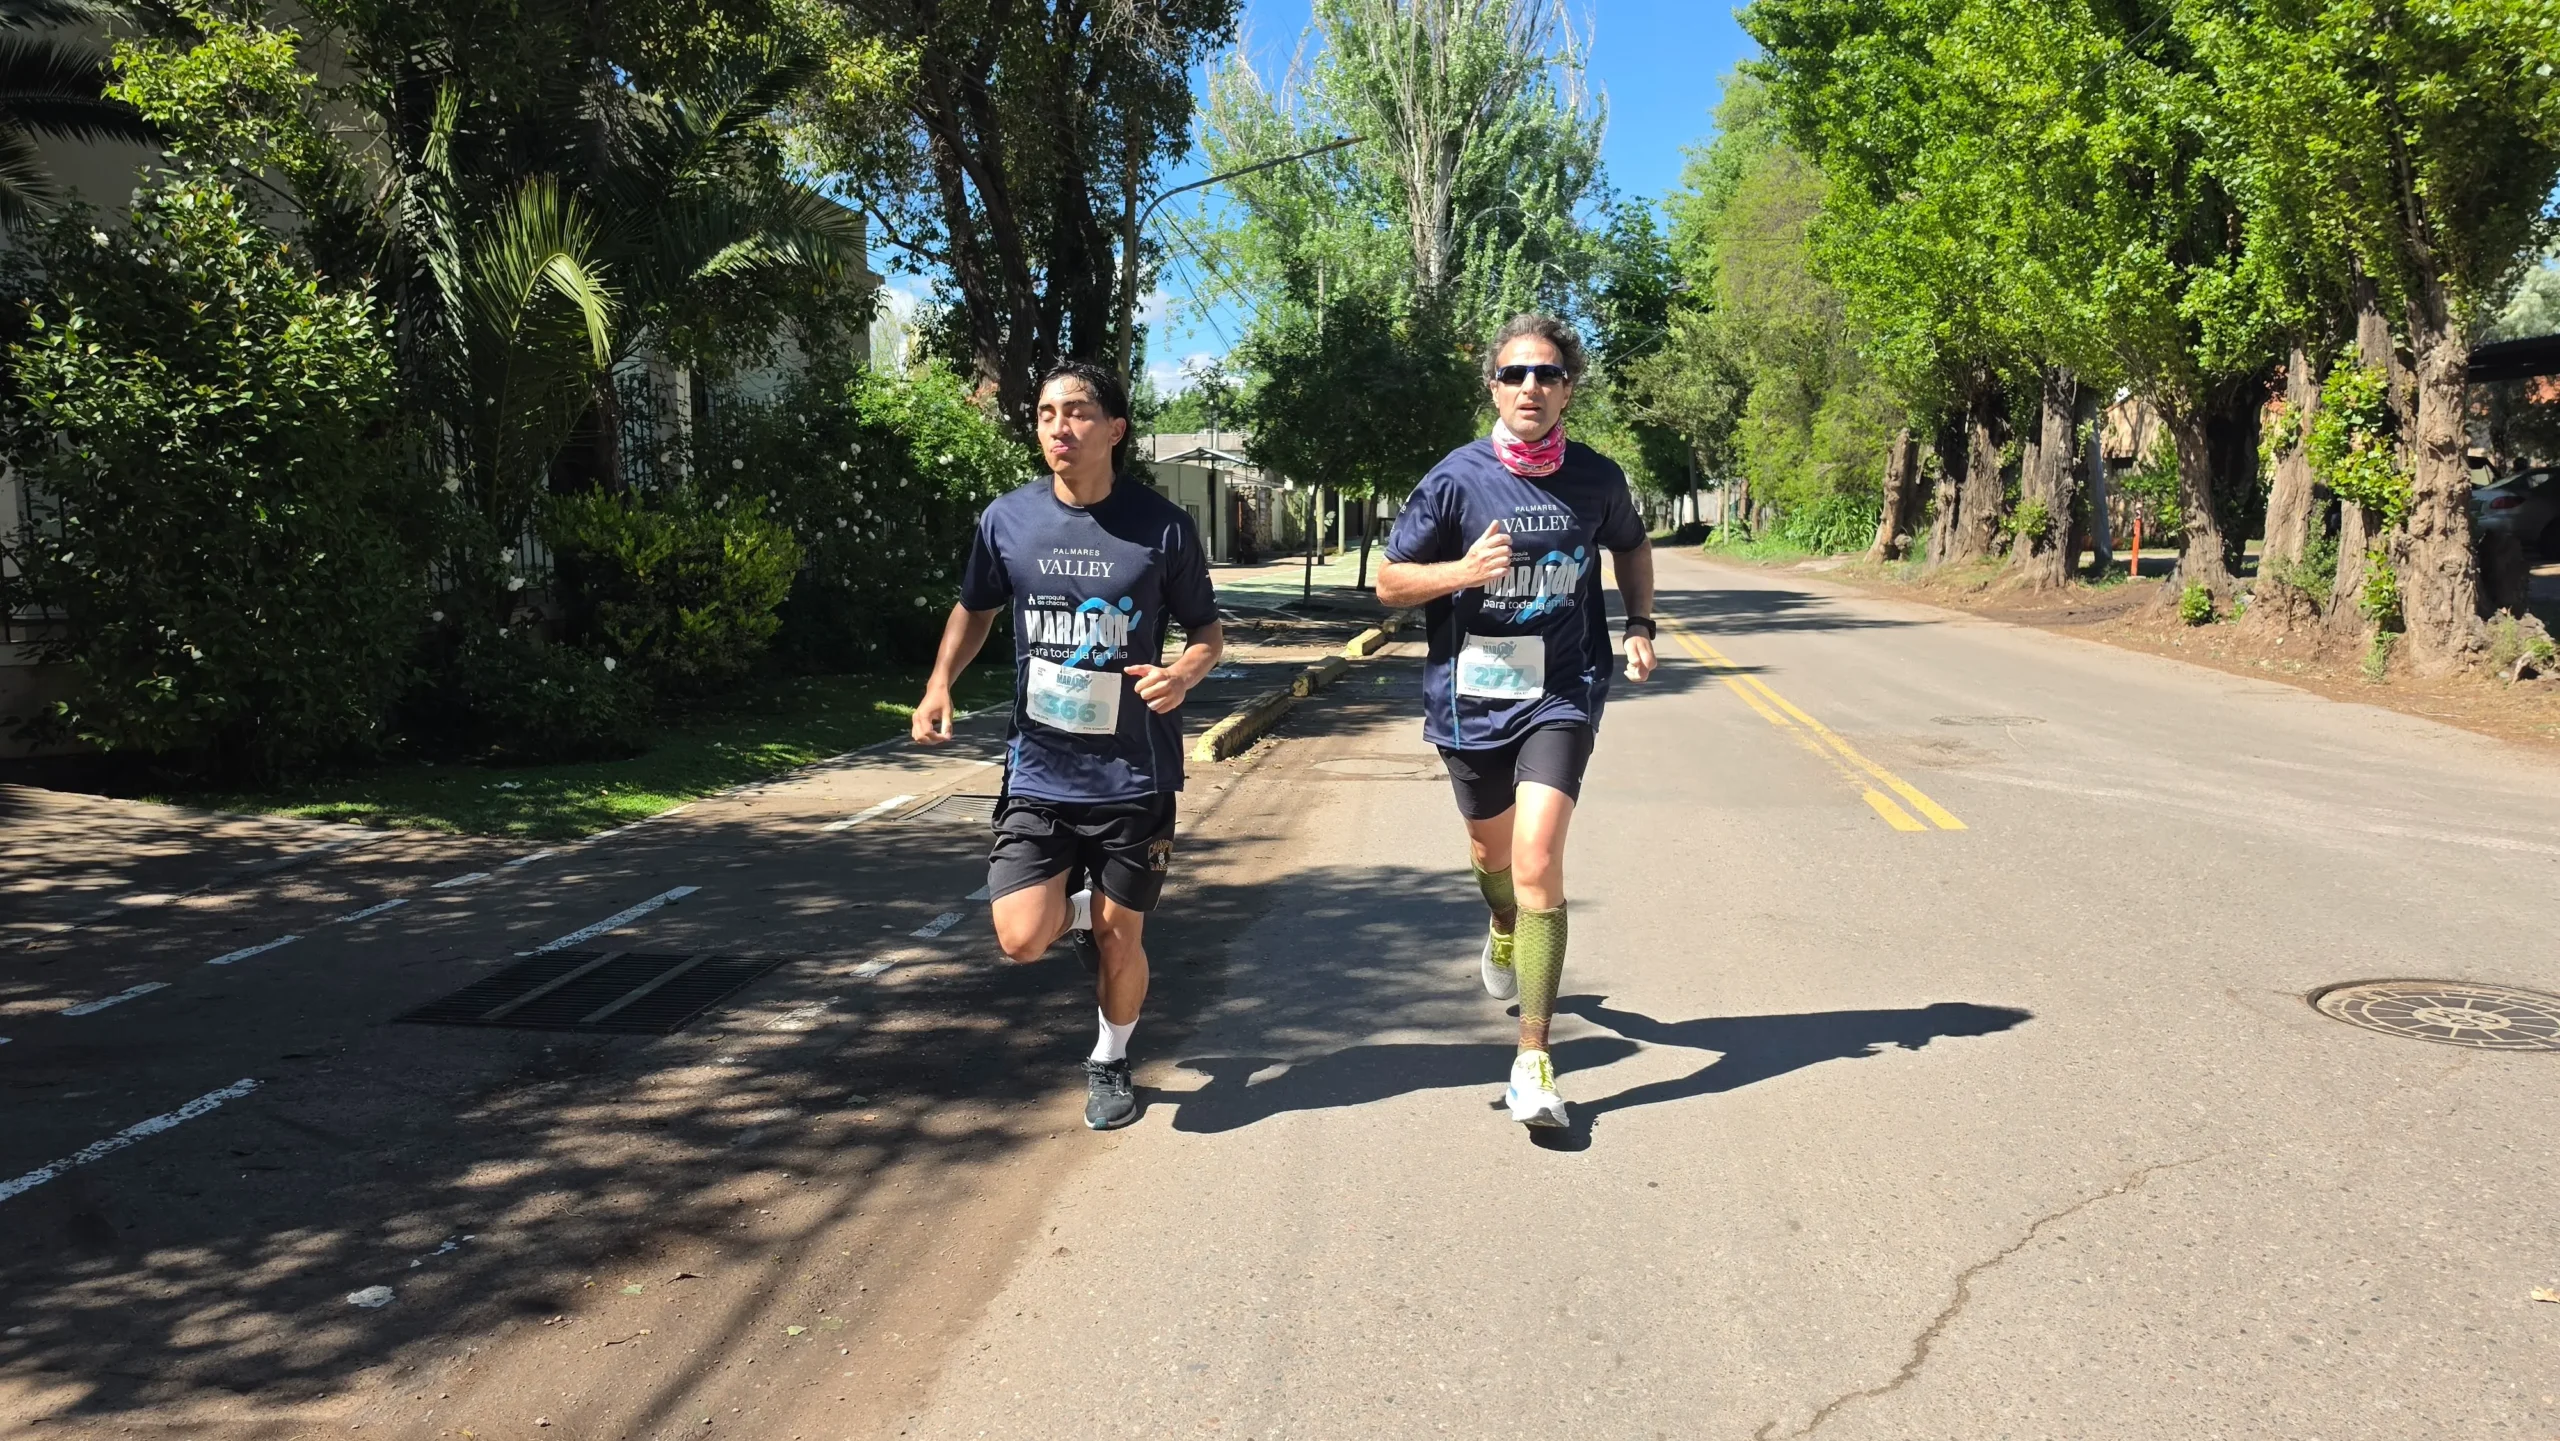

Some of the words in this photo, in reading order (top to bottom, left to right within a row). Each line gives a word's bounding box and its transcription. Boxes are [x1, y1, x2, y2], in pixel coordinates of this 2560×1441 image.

[1515, 504, 1557, 513] PALMARES
[1502, 515, 1570, 533] VALLEY
[1052, 548, 1100, 556] PALMARES
[1037, 559, 1115, 578] VALLEY
[1482, 599, 1506, 610] para
[1508, 600, 1533, 609] toda
[1535, 600, 1545, 610] la
[1050, 647, 1076, 659] toda
[1474, 666, 1524, 688] 277
[1042, 692, 1096, 723] 366
